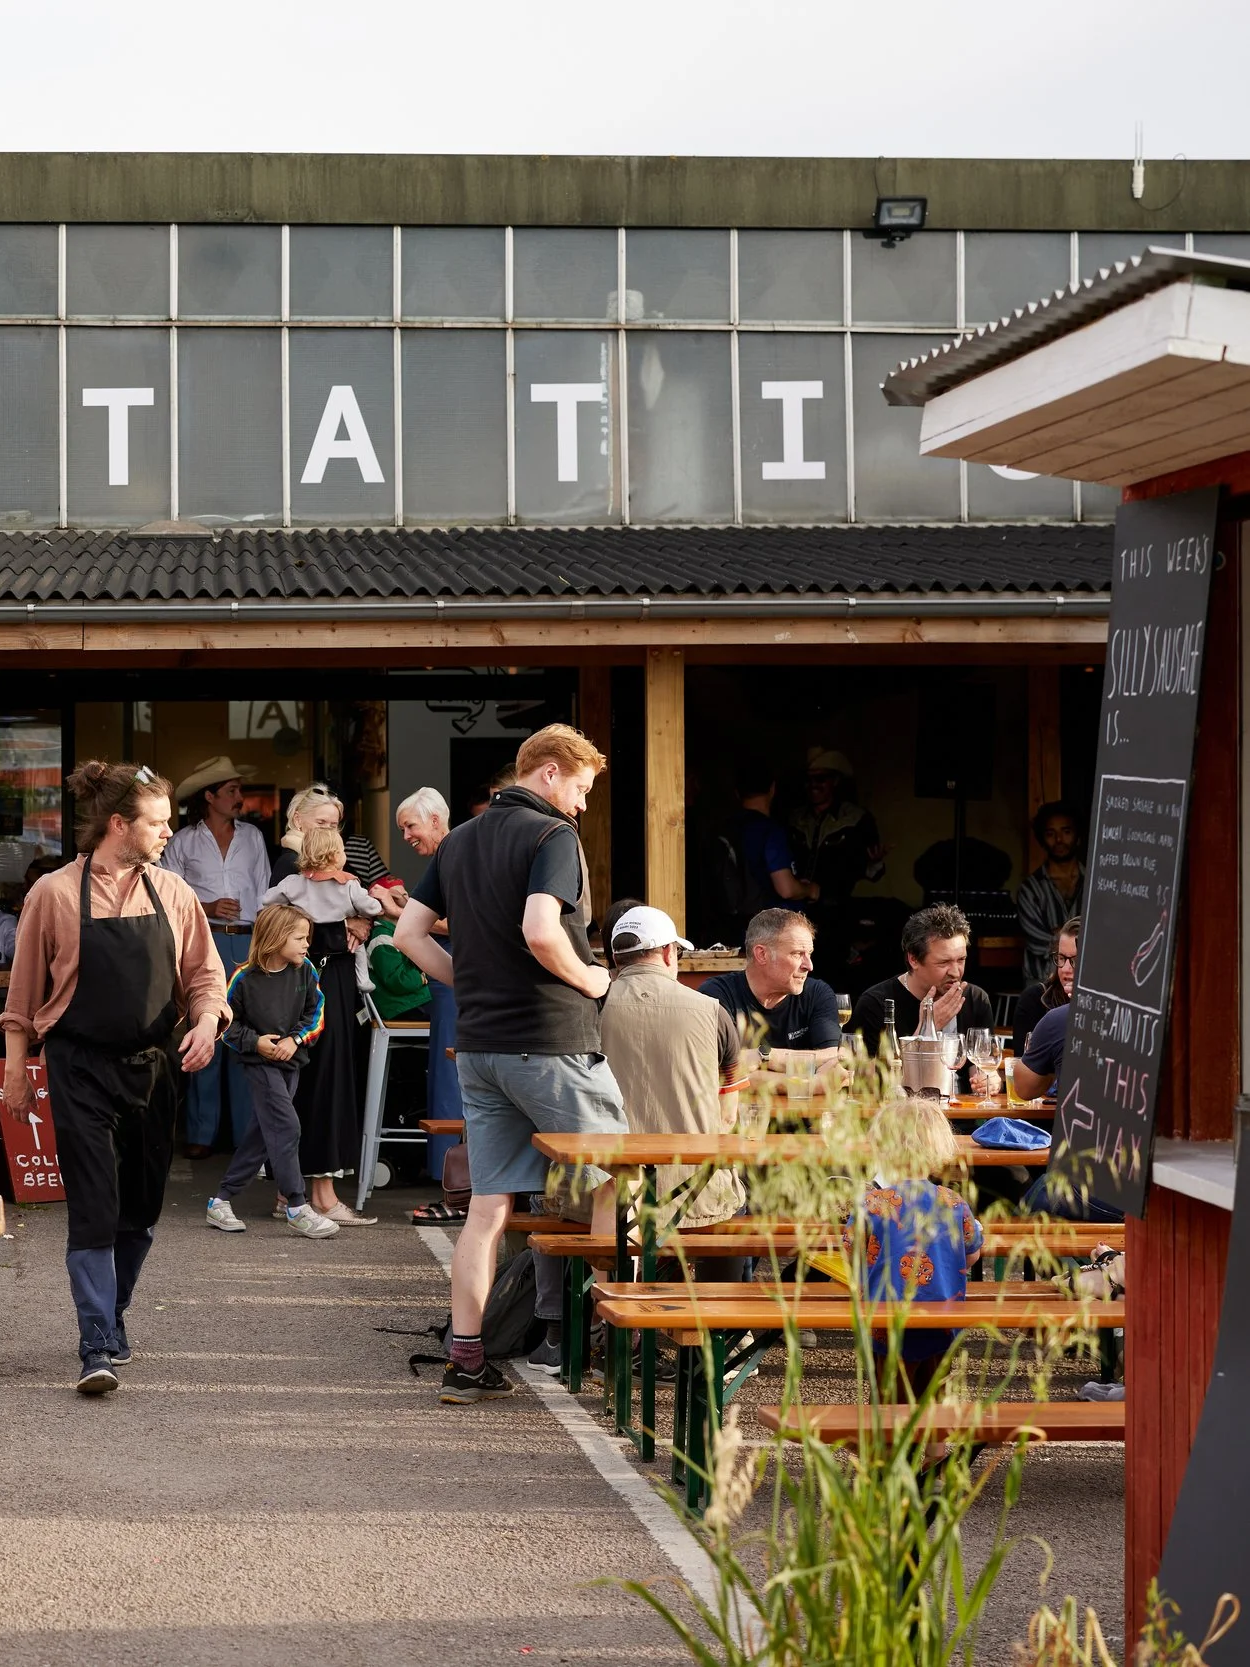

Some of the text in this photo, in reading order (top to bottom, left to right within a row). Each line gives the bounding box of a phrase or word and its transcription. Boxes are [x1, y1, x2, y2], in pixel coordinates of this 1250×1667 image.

[1121, 544, 1153, 582] THIS
[1108, 621, 1202, 699] SILLY SAUSAGE
[1074, 1012, 1086, 1031] FRI
[1108, 1003, 1133, 1044] AND
[16, 1154, 60, 1168] COL
[24, 1172, 65, 1187] BEE
